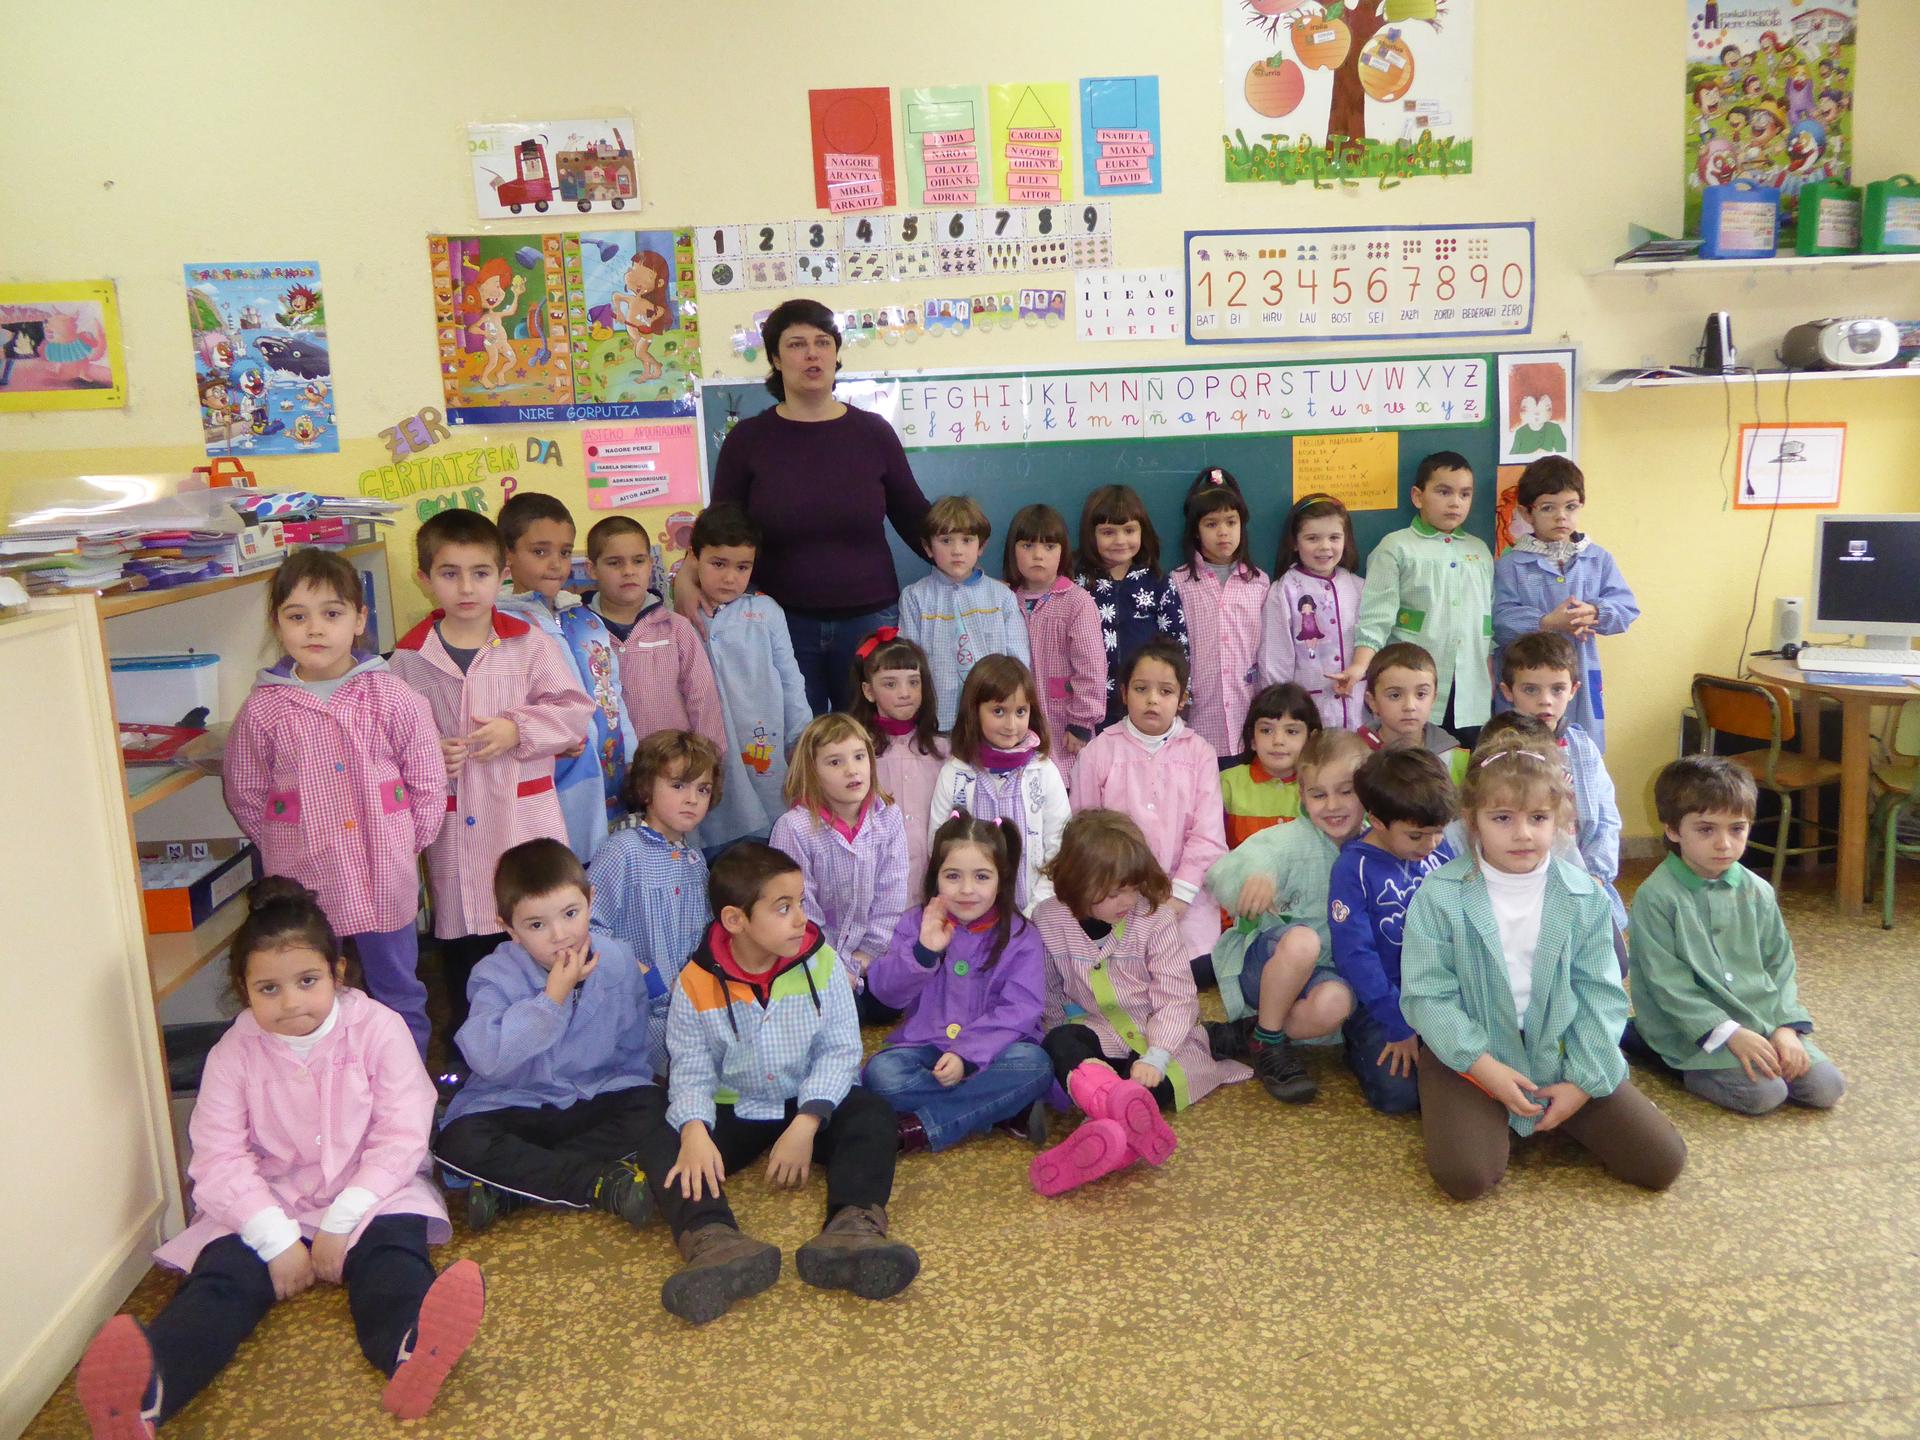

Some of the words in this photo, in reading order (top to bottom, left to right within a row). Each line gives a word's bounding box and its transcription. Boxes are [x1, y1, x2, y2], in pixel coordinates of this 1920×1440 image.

[933, 133, 964, 145] LYDIA
[1011, 131, 1061, 140] CAROLINA
[1102, 132, 1144, 141] ISABELA
[1011, 147, 1053, 159] NAGORE
[1110, 146, 1147, 155] MAYKA
[831, 157, 874, 168] NAGORE
[1014, 160, 1047, 169] OIHAN
[1105, 158, 1139, 169] EUKEN
[934, 164, 969, 175] OLATZ
[829, 170, 878, 182] ARANTXA
[930, 177, 963, 187] OIHAN
[1016, 175, 1048, 185] JULEN
[1110, 173, 1141, 183] DAVID
[840, 185, 874, 196] MIKEL
[1019, 190, 1051, 200] AITOR
[931, 193, 969, 202] ADRIAN
[834, 197, 879, 211] ARKAITZ
[713, 229, 725, 255] 1
[758, 226, 775, 252] 2
[808, 223, 825, 248] 3
[855, 218, 873, 244] 4
[901, 215, 918, 243] 5
[949, 213, 965, 239] 6
[994, 210, 1011, 236] 7
[1037, 207, 1053, 235] 8
[1083, 206, 1098, 233] 9
[1138, 274, 1147, 283] O
[1197, 271, 1212, 307] 1
[1227, 270, 1248, 307] 2
[1262, 269, 1284, 307] 3
[1297, 268, 1318, 305] 4
[1332, 267, 1353, 305] 5
[1367, 266, 1388, 304] 6
[1402, 266, 1421, 302] 7
[1436, 264, 1456, 301] 8
[1470, 264, 1488, 299] 9
[1502, 262, 1523, 299] 0
[1103, 290, 1113, 301] U
[1125, 290, 1134, 300] E
[1146, 289, 1155, 299] A
[1164, 288, 1174, 298] O
[1085, 309, 1093, 319] U
[1127, 307, 1135, 317] A
[1147, 306, 1156, 316] O
[1168, 306, 1175, 316] E
[1196, 313, 1215, 327] BAT
[1229, 313, 1242, 325] BI
[1299, 311, 1317, 324] LAU
[1331, 312, 1353, 324] BOST
[1368, 311, 1384, 324] SEI
[1400, 308, 1420, 321] ZAZPI
[1433, 308, 1455, 321] ZORTZI
[1461, 307, 1497, 320] BEDERATZI
[1500, 303, 1523, 317] ZERO
[1085, 327, 1094, 337] A
[1106, 326, 1115, 336] U
[1128, 325, 1137, 335] E
[1170, 323, 1179, 333] U
[901, 388, 914, 411] E
[924, 387, 938, 410] F
[947, 386, 964, 409] G
[973, 384, 989, 409] H
[998, 384, 1011, 407] I
[1019, 383, 1033, 406] J
[1042, 382, 1055, 406] K
[1065, 381, 1078, 404] L
[1090, 380, 1108, 403] M
[1121, 379, 1138, 403] N
[1147, 377, 1164, 402] Ñ
[1176, 376, 1195, 400] O
[1205, 375, 1220, 399] P
[1230, 374, 1247, 400] Q
[1256, 372, 1272, 397] R
[1280, 371, 1294, 395] S
[1302, 370, 1321, 394] T
[1330, 369, 1347, 393] U
[1355, 367, 1374, 391] V
[1384, 366, 1405, 391] W
[1416, 364, 1432, 389] X
[1441, 364, 1456, 389] Y
[1464, 363, 1479, 388] Z
[519, 407, 555, 421] NIRE
[566, 404, 640, 419] GORPUTZA
[902, 423, 917, 436] e
[928, 410, 937, 438] f
[948, 420, 966, 443] g
[974, 410, 991, 432] h
[1001, 415, 1010, 432] i
[1042, 407, 1057, 430] k
[1067, 406, 1078, 429] l
[1087, 415, 1113, 428] m
[1121, 413, 1140, 426] n
[1149, 409, 1168, 426] ñ
[1178, 411, 1197, 424] o
[1205, 410, 1221, 431] p
[1230, 408, 1248, 431] q
[1257, 408, 1271, 420] r
[1280, 407, 1294, 420] s
[1307, 397, 1317, 417] t
[1330, 404, 1347, 417] u
[1356, 402, 1373, 416] v
[1383, 401, 1407, 414] w
[1415, 401, 1432, 414] x
[1440, 399, 1455, 421] y
[1463, 399, 1478, 411] z
[378, 406, 451, 464] ZER
[584, 428, 624, 441] ASTEKO
[358, 442, 521, 501] GERTATZEN
[526, 436, 563, 467] DA
[619, 493, 639, 502] AITOR
[639, 487, 660, 497] ANZAR
[195, 845, 205, 856] N
